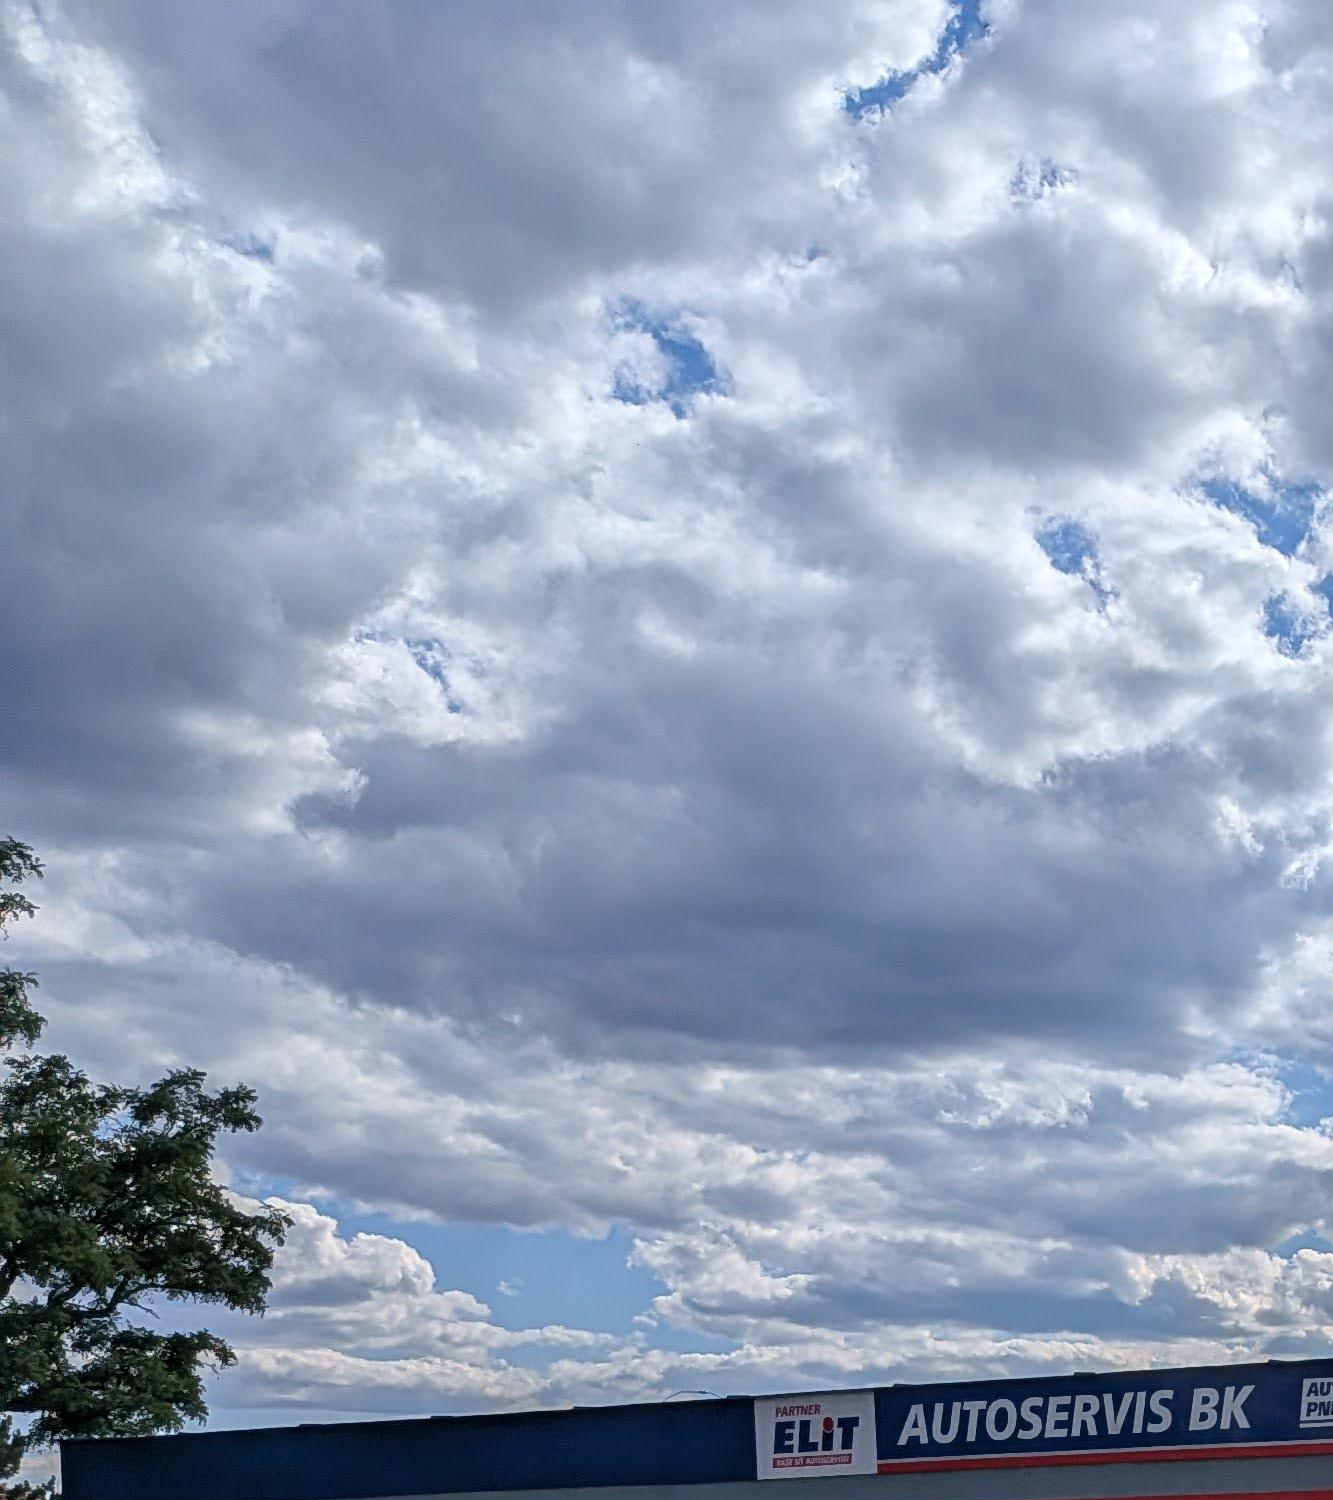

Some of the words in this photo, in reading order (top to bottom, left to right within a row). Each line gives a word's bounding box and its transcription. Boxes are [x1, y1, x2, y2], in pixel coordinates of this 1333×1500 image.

[775, 1404, 820, 1417] PARTNER
[897, 1389, 1173, 1446] AUTOSERVIS
[1189, 1385, 1255, 1432] BK
